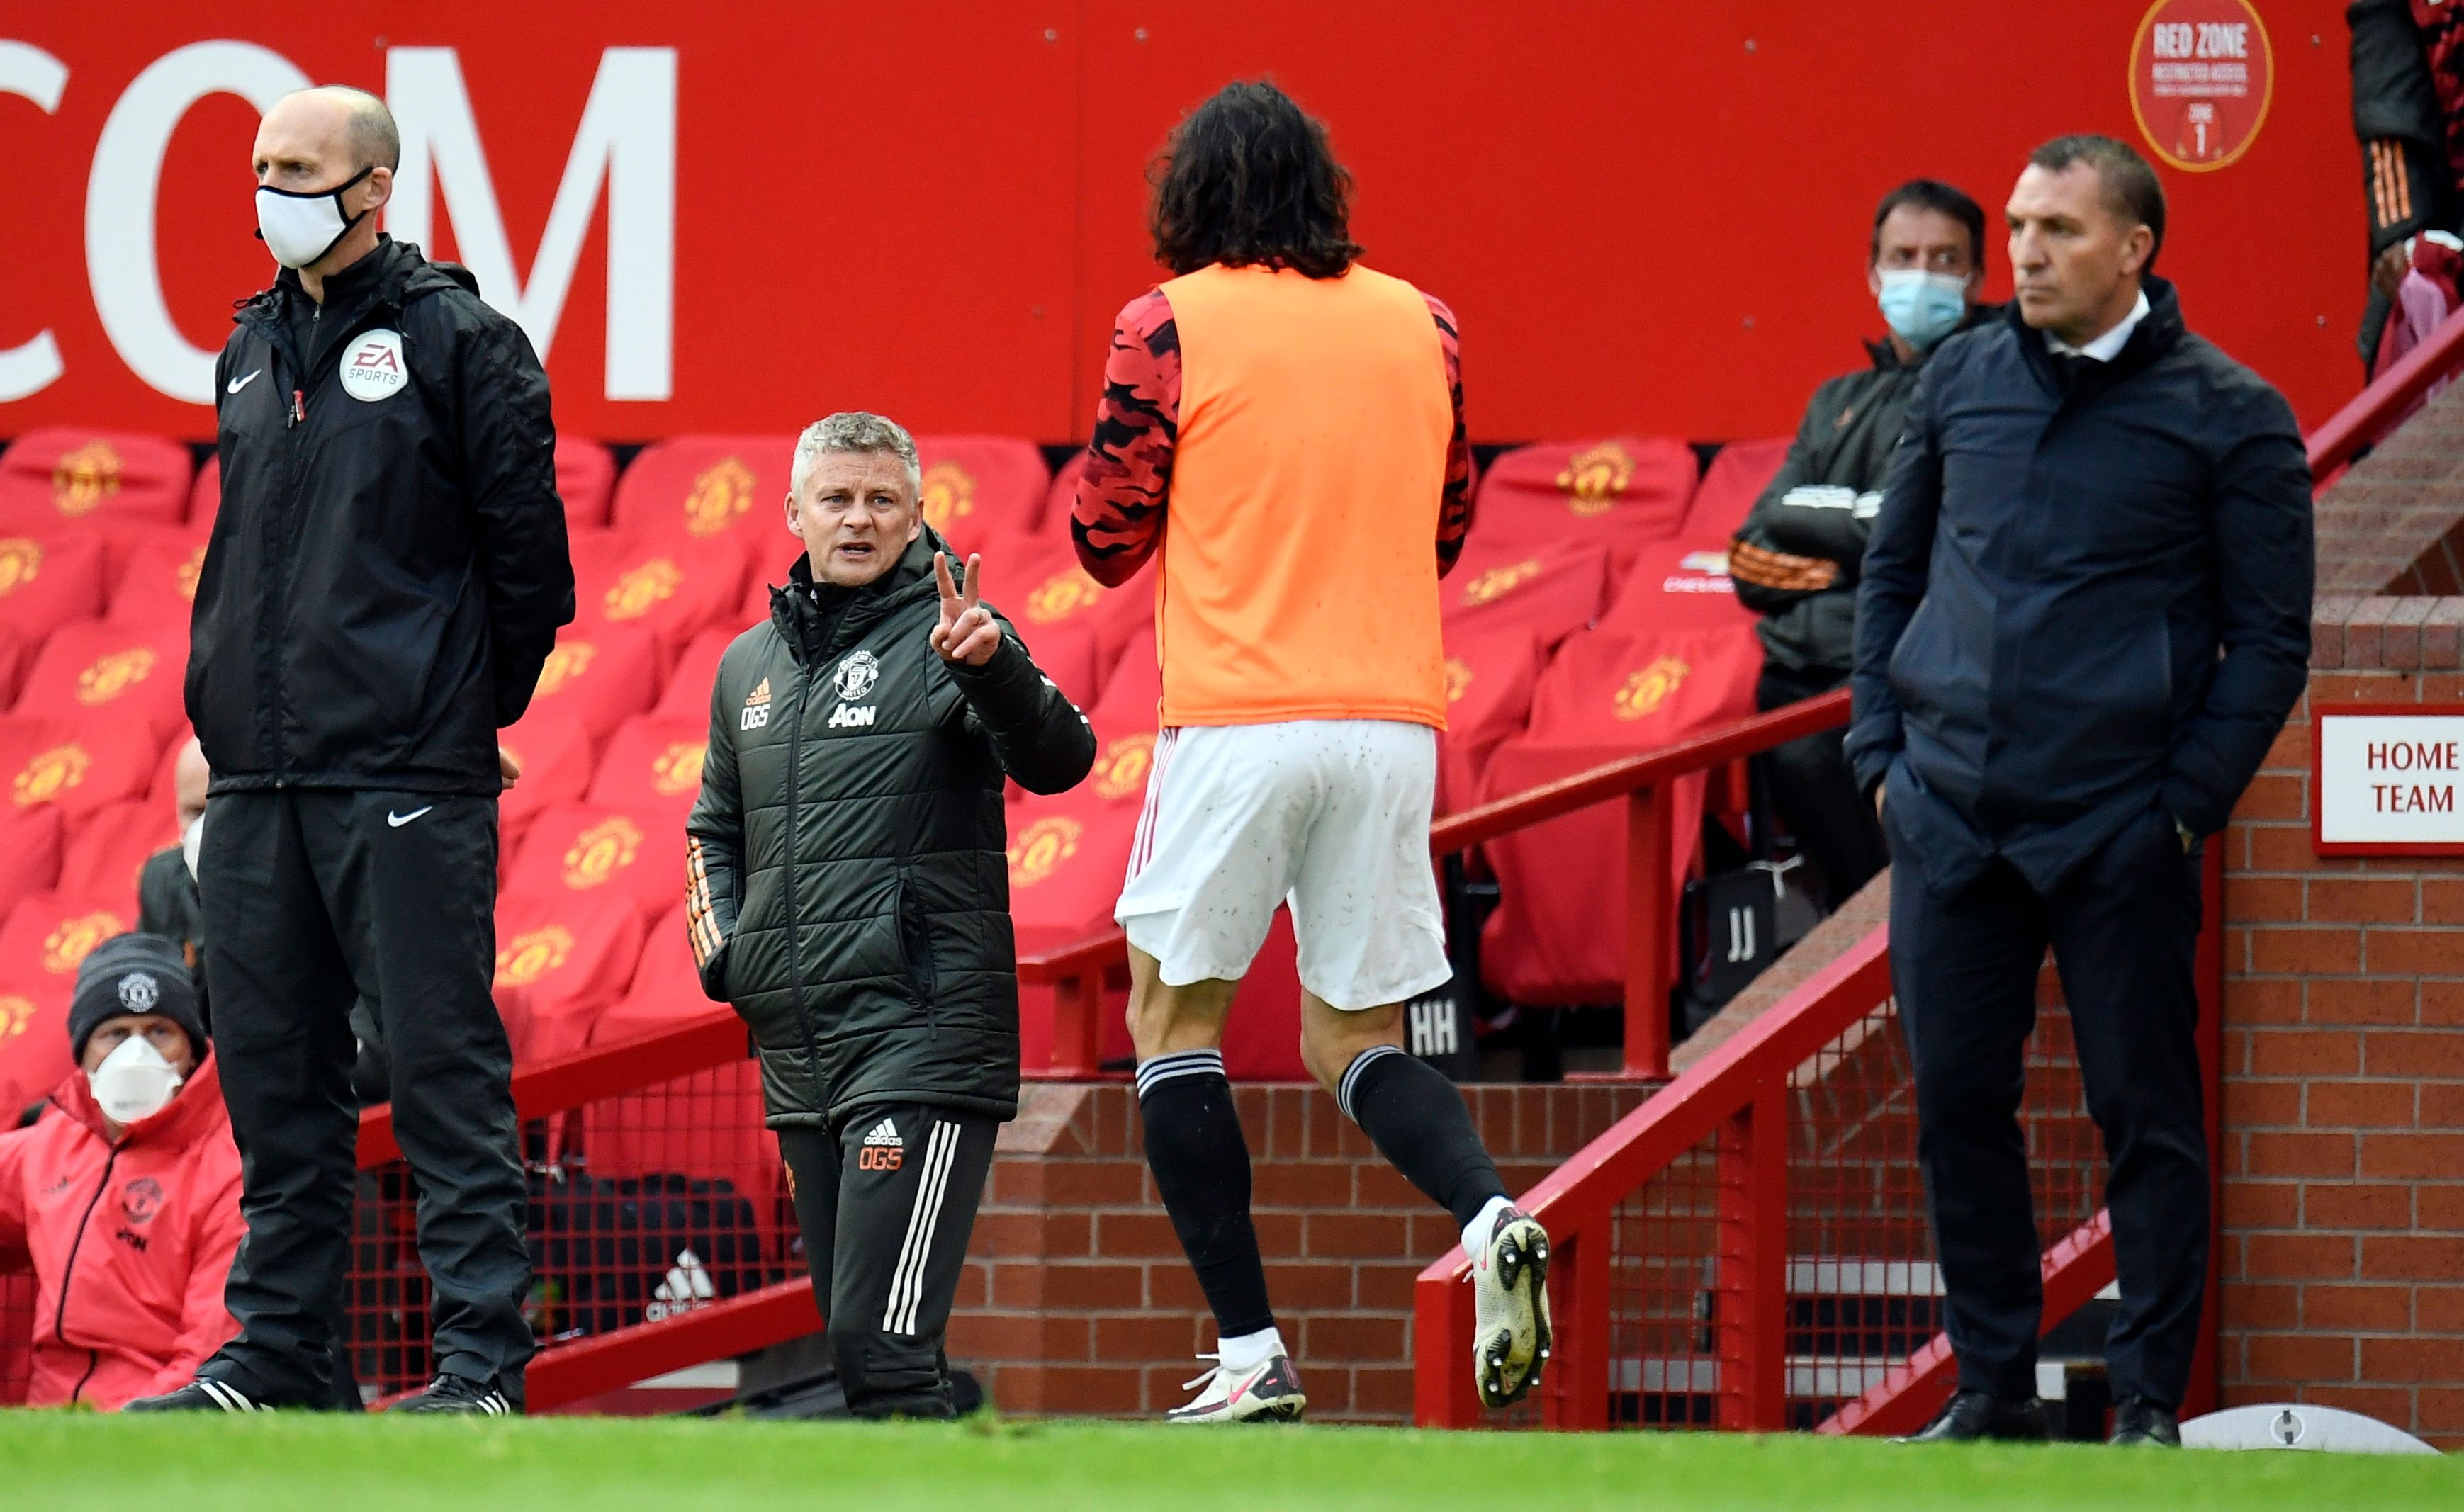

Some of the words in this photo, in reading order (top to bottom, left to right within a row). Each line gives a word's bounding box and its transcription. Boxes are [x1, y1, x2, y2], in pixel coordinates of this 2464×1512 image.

[2154, 23, 2193, 58] RED
[2196, 23, 2249, 58] ZONE
[2195, 123, 2206, 157] 1
[353, 344, 399, 373] EA
[349, 368, 398, 385] SPORTS
[740, 703, 771, 731] OGS
[828, 702, 877, 729] AON
[2367, 742, 2459, 771] HOME
[2370, 784, 2454, 813] TEAM
[1728, 906, 1755, 963] JJ
[1410, 998, 1458, 1056] HH
[863, 1134, 903, 1146] adidas
[859, 1146, 904, 1170] OGS
